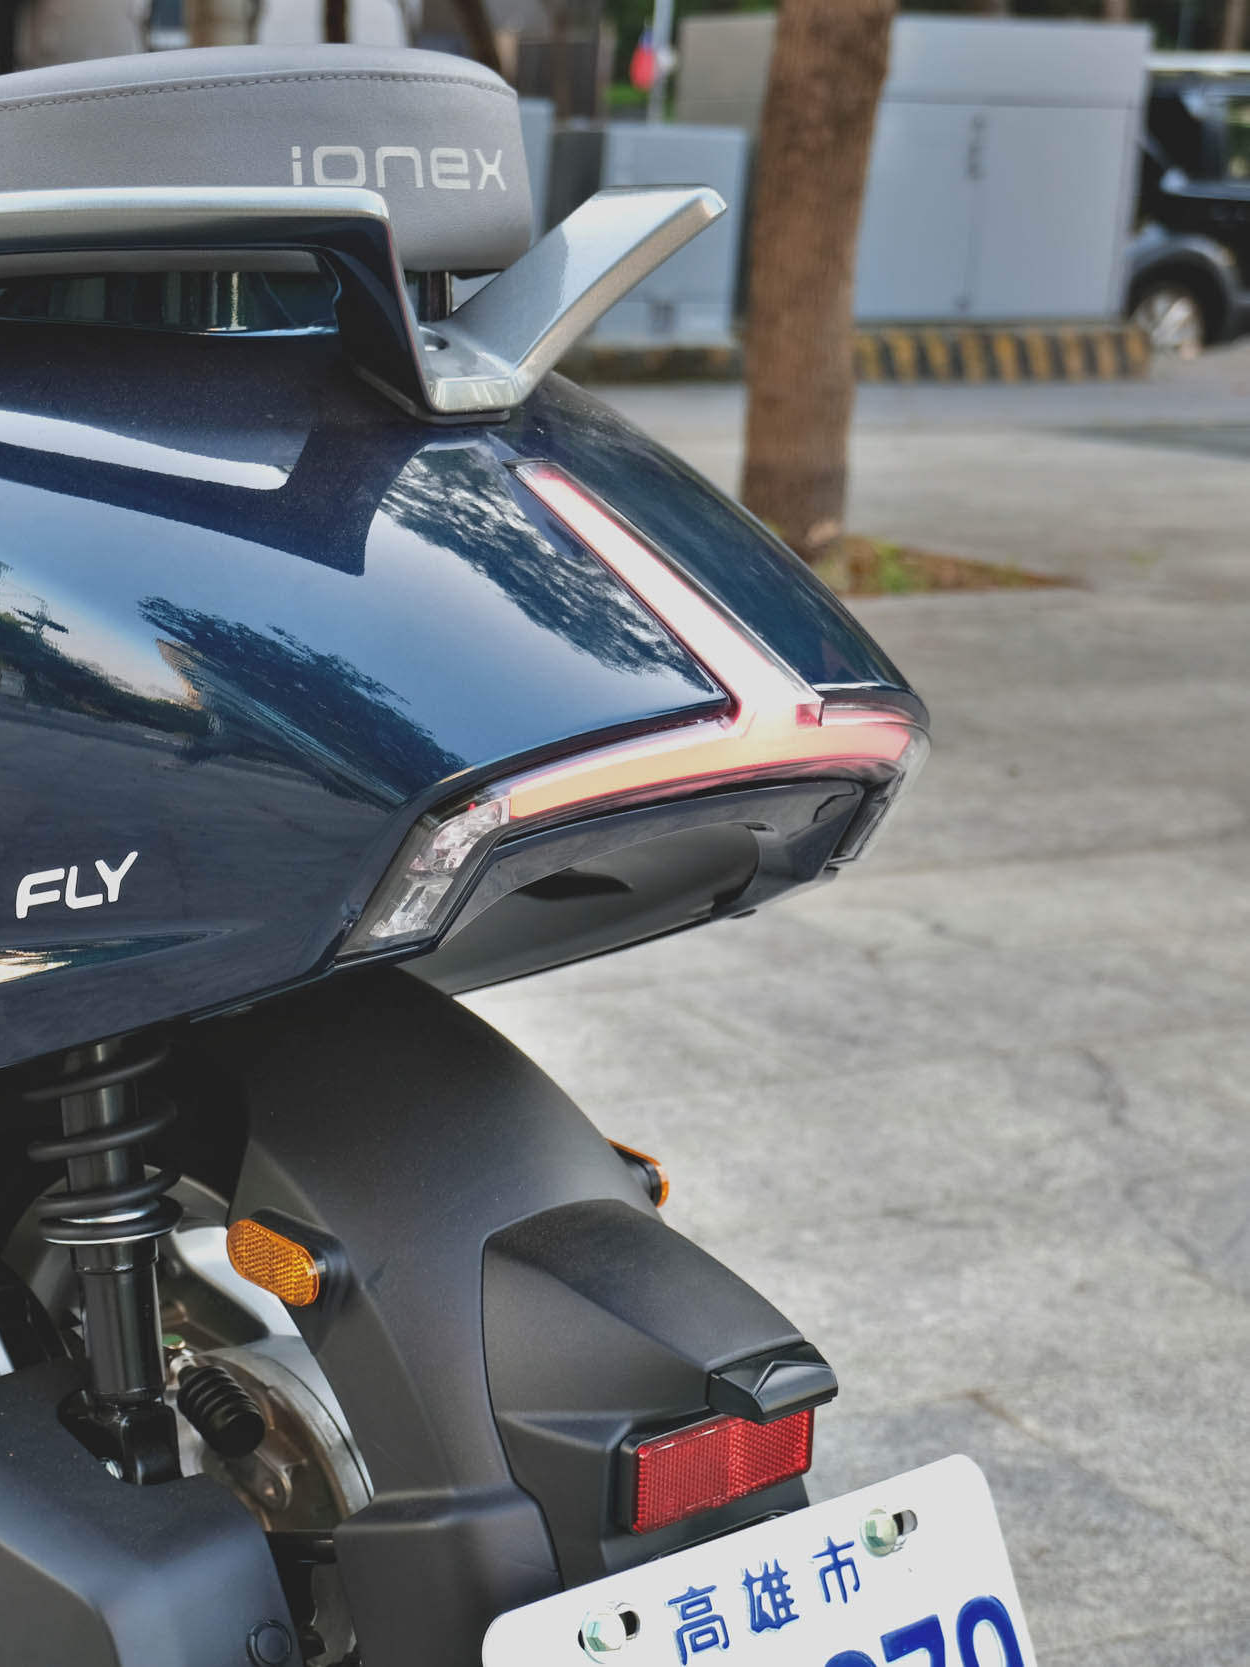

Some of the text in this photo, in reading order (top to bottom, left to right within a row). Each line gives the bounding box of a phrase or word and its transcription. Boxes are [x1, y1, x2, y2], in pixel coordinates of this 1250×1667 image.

[291, 145, 507, 191] ionex
[15, 850, 139, 919] FLY
[666, 1535, 861, 1666] 高雄市
